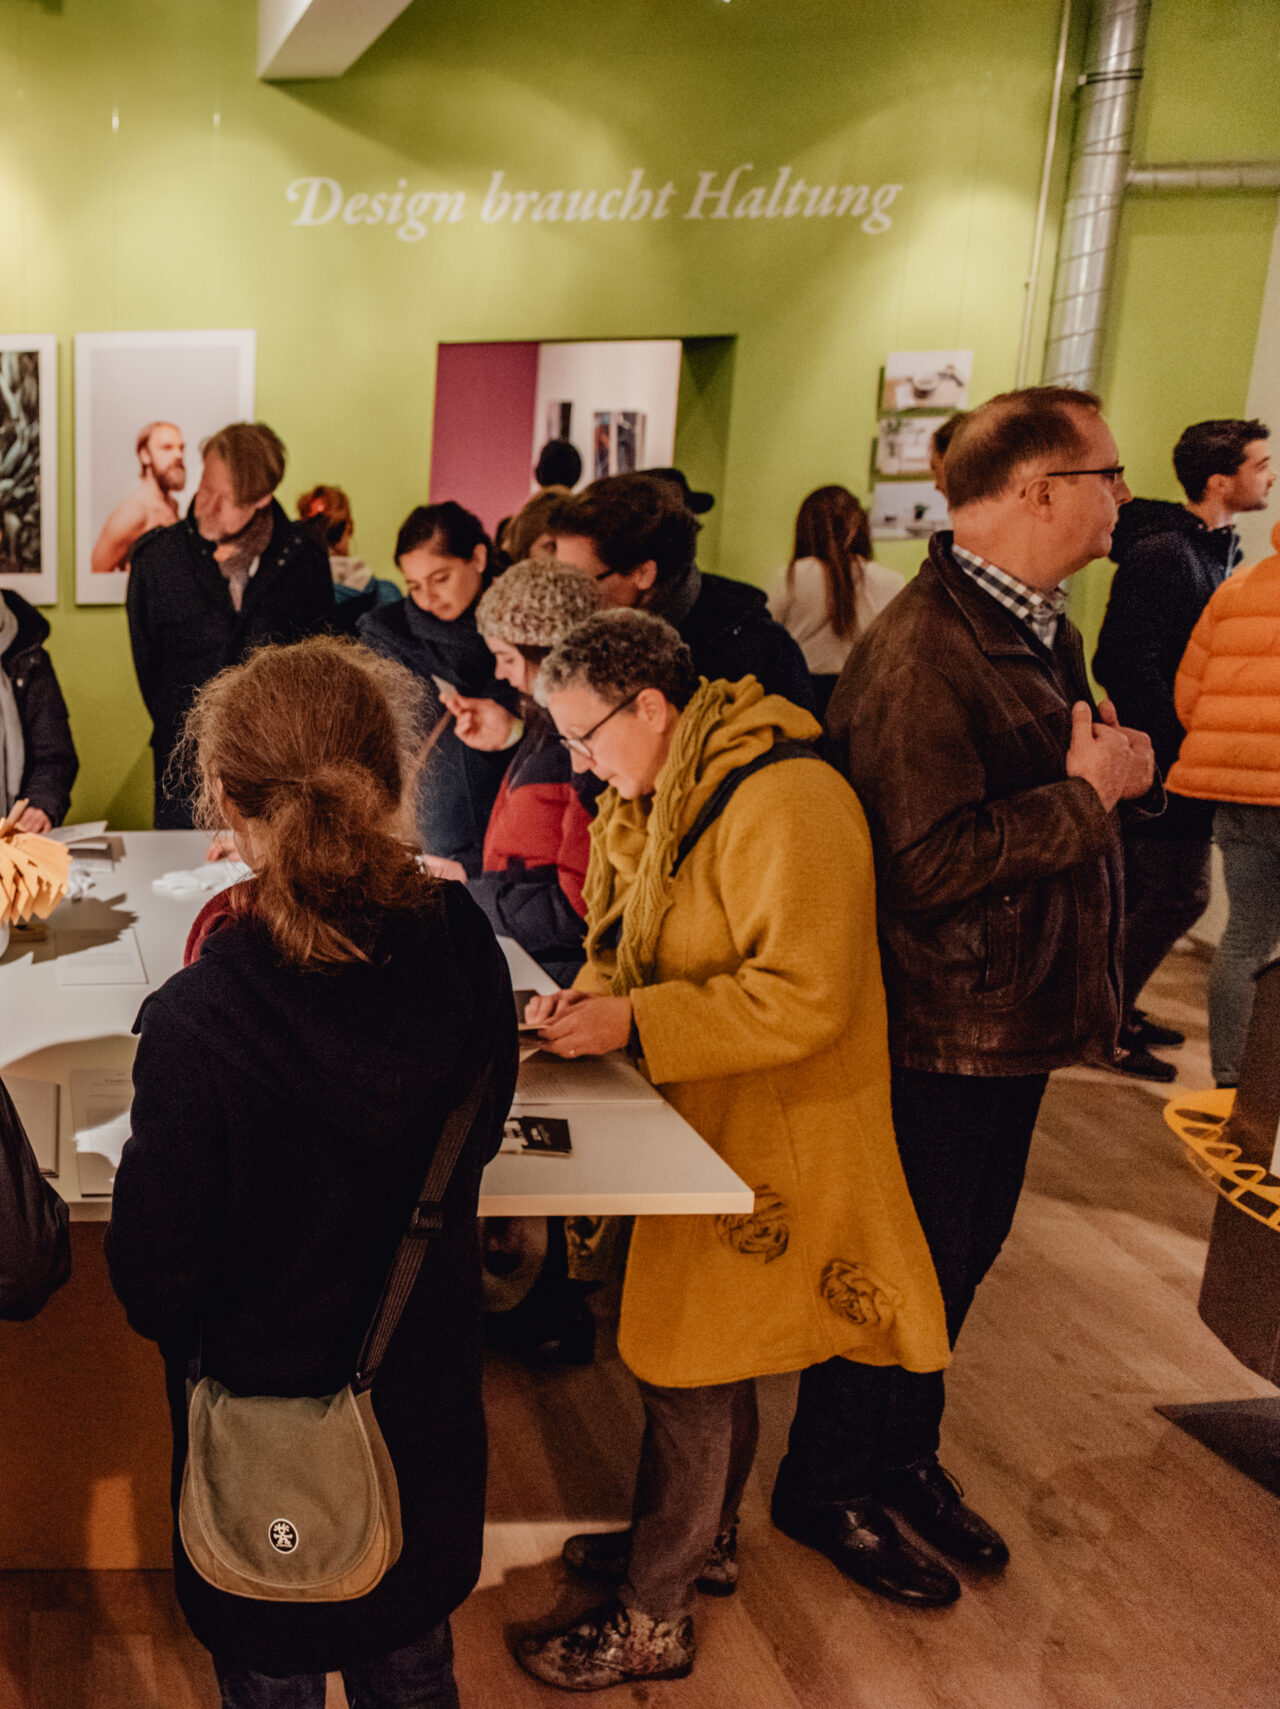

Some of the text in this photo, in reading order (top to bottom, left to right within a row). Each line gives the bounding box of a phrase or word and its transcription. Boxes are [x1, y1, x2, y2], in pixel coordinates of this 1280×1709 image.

[285, 162, 903, 243] Design braucht Haltung
